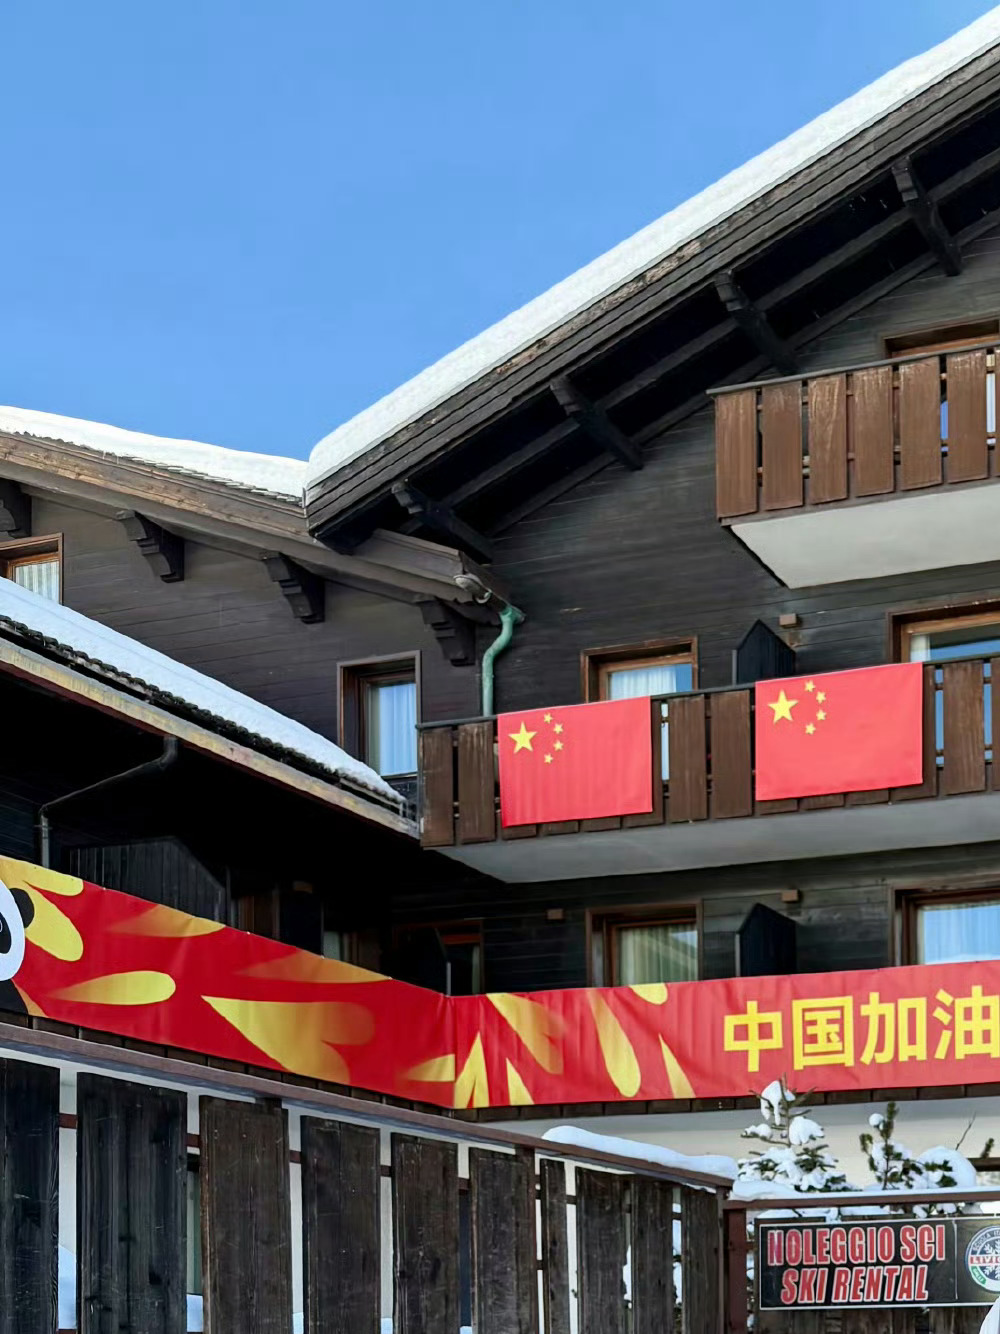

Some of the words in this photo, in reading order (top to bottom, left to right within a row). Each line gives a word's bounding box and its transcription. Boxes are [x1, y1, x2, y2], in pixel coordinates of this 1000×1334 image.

[767, 1226, 895, 1266] NOLEGGIO
[900, 1224, 946, 1262] SCI
[780, 1268, 828, 1305] SKI
[831, 1265, 928, 1304] RENTAL
